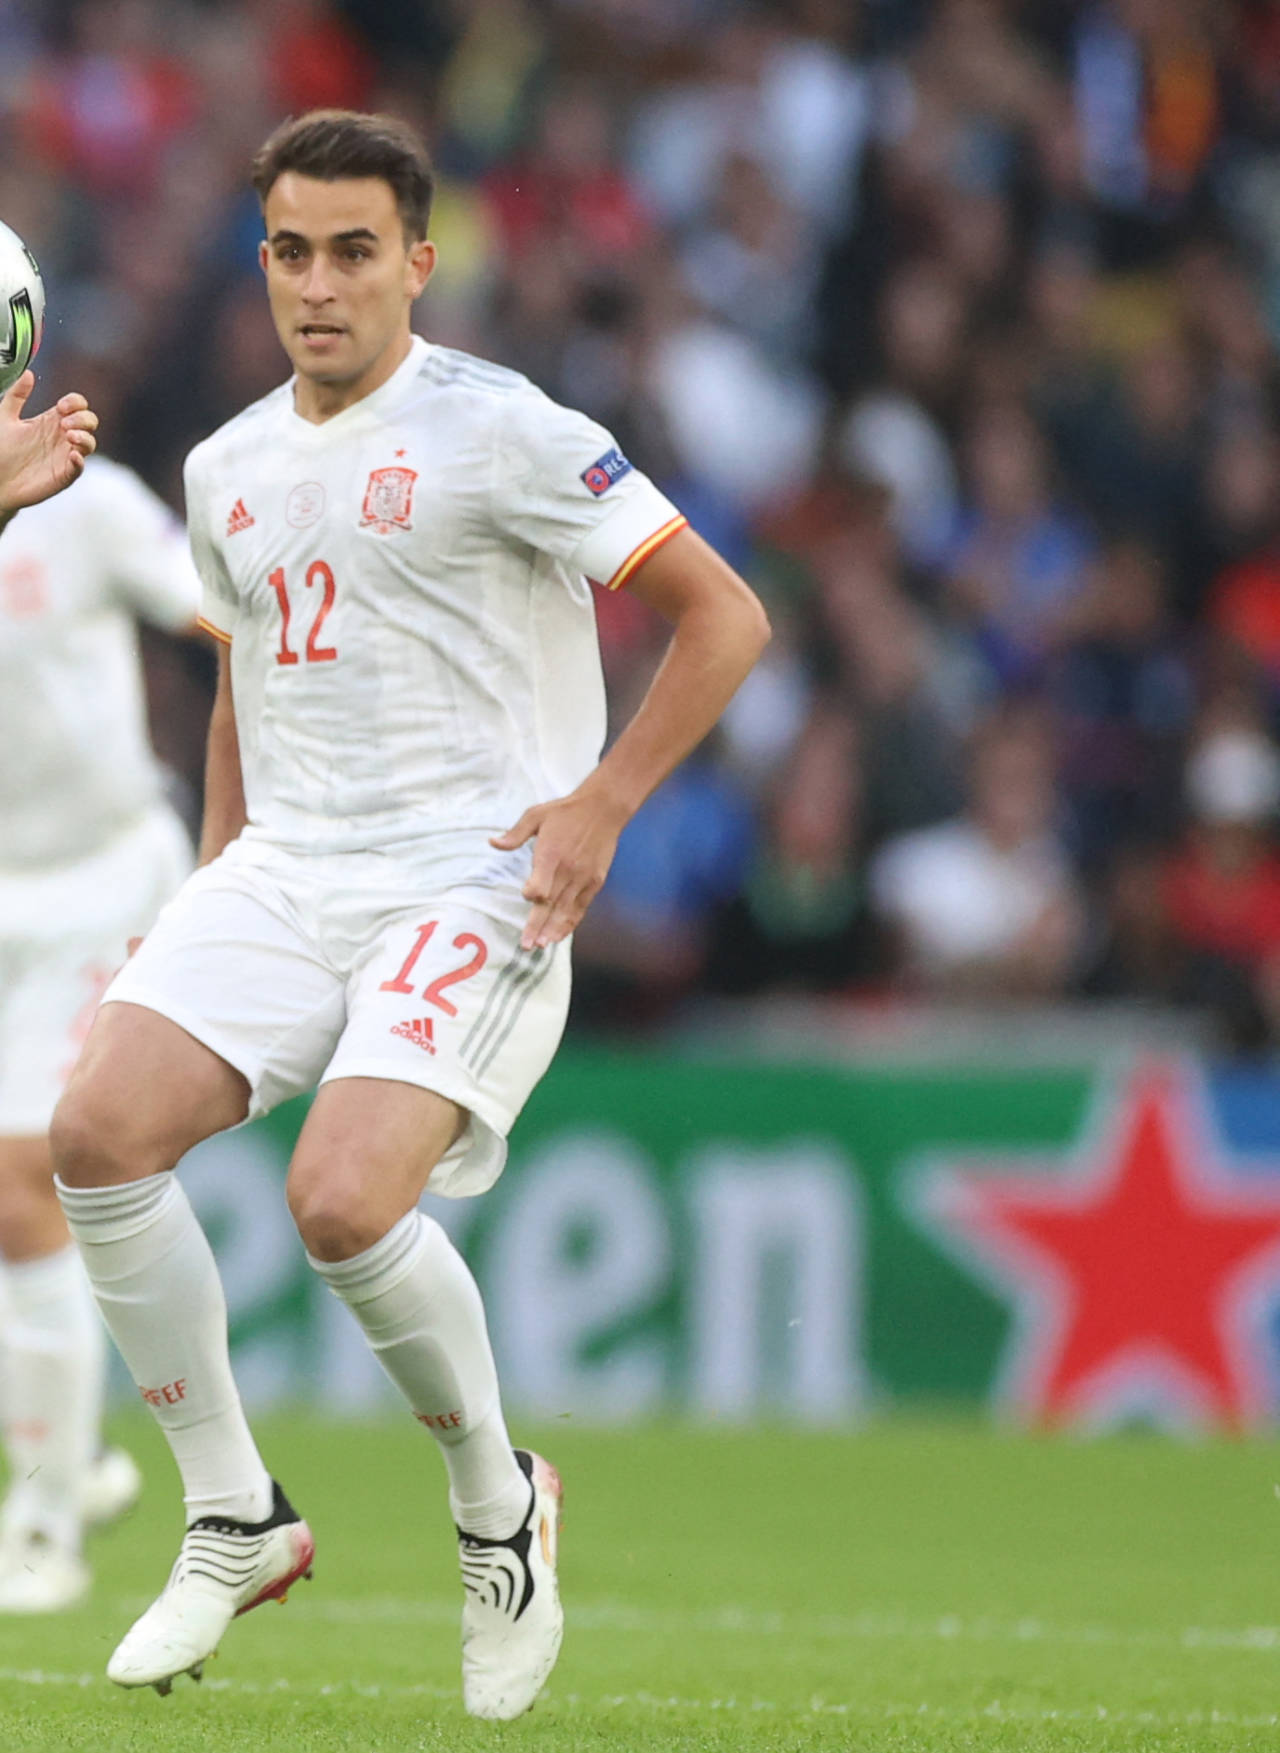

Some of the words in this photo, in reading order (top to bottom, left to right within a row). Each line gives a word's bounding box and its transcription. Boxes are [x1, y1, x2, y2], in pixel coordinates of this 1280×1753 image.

[268, 559, 337, 666] 12
[378, 920, 488, 1018] 12
[390, 1025, 436, 1056] adidas
